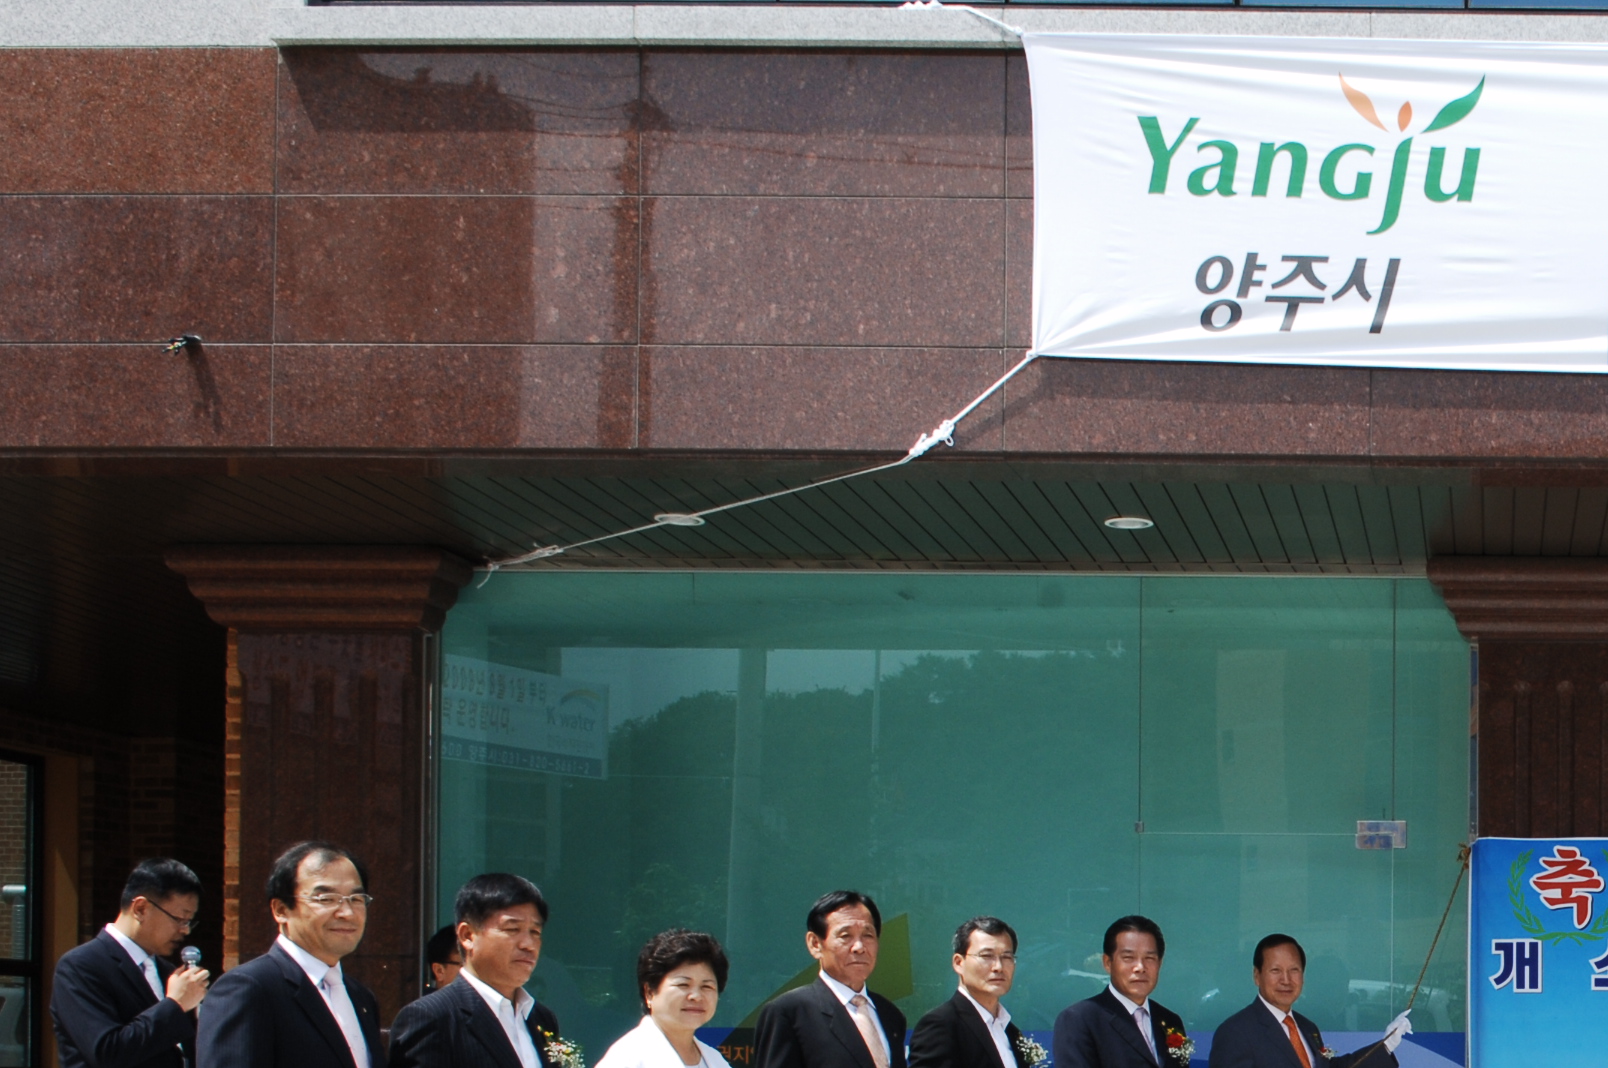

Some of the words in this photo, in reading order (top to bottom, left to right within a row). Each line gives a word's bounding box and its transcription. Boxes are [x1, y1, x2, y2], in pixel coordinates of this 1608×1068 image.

[1194, 252, 1400, 334] 양주시
[1529, 845, 1604, 930] 축
[1489, 938, 1543, 993] 개
